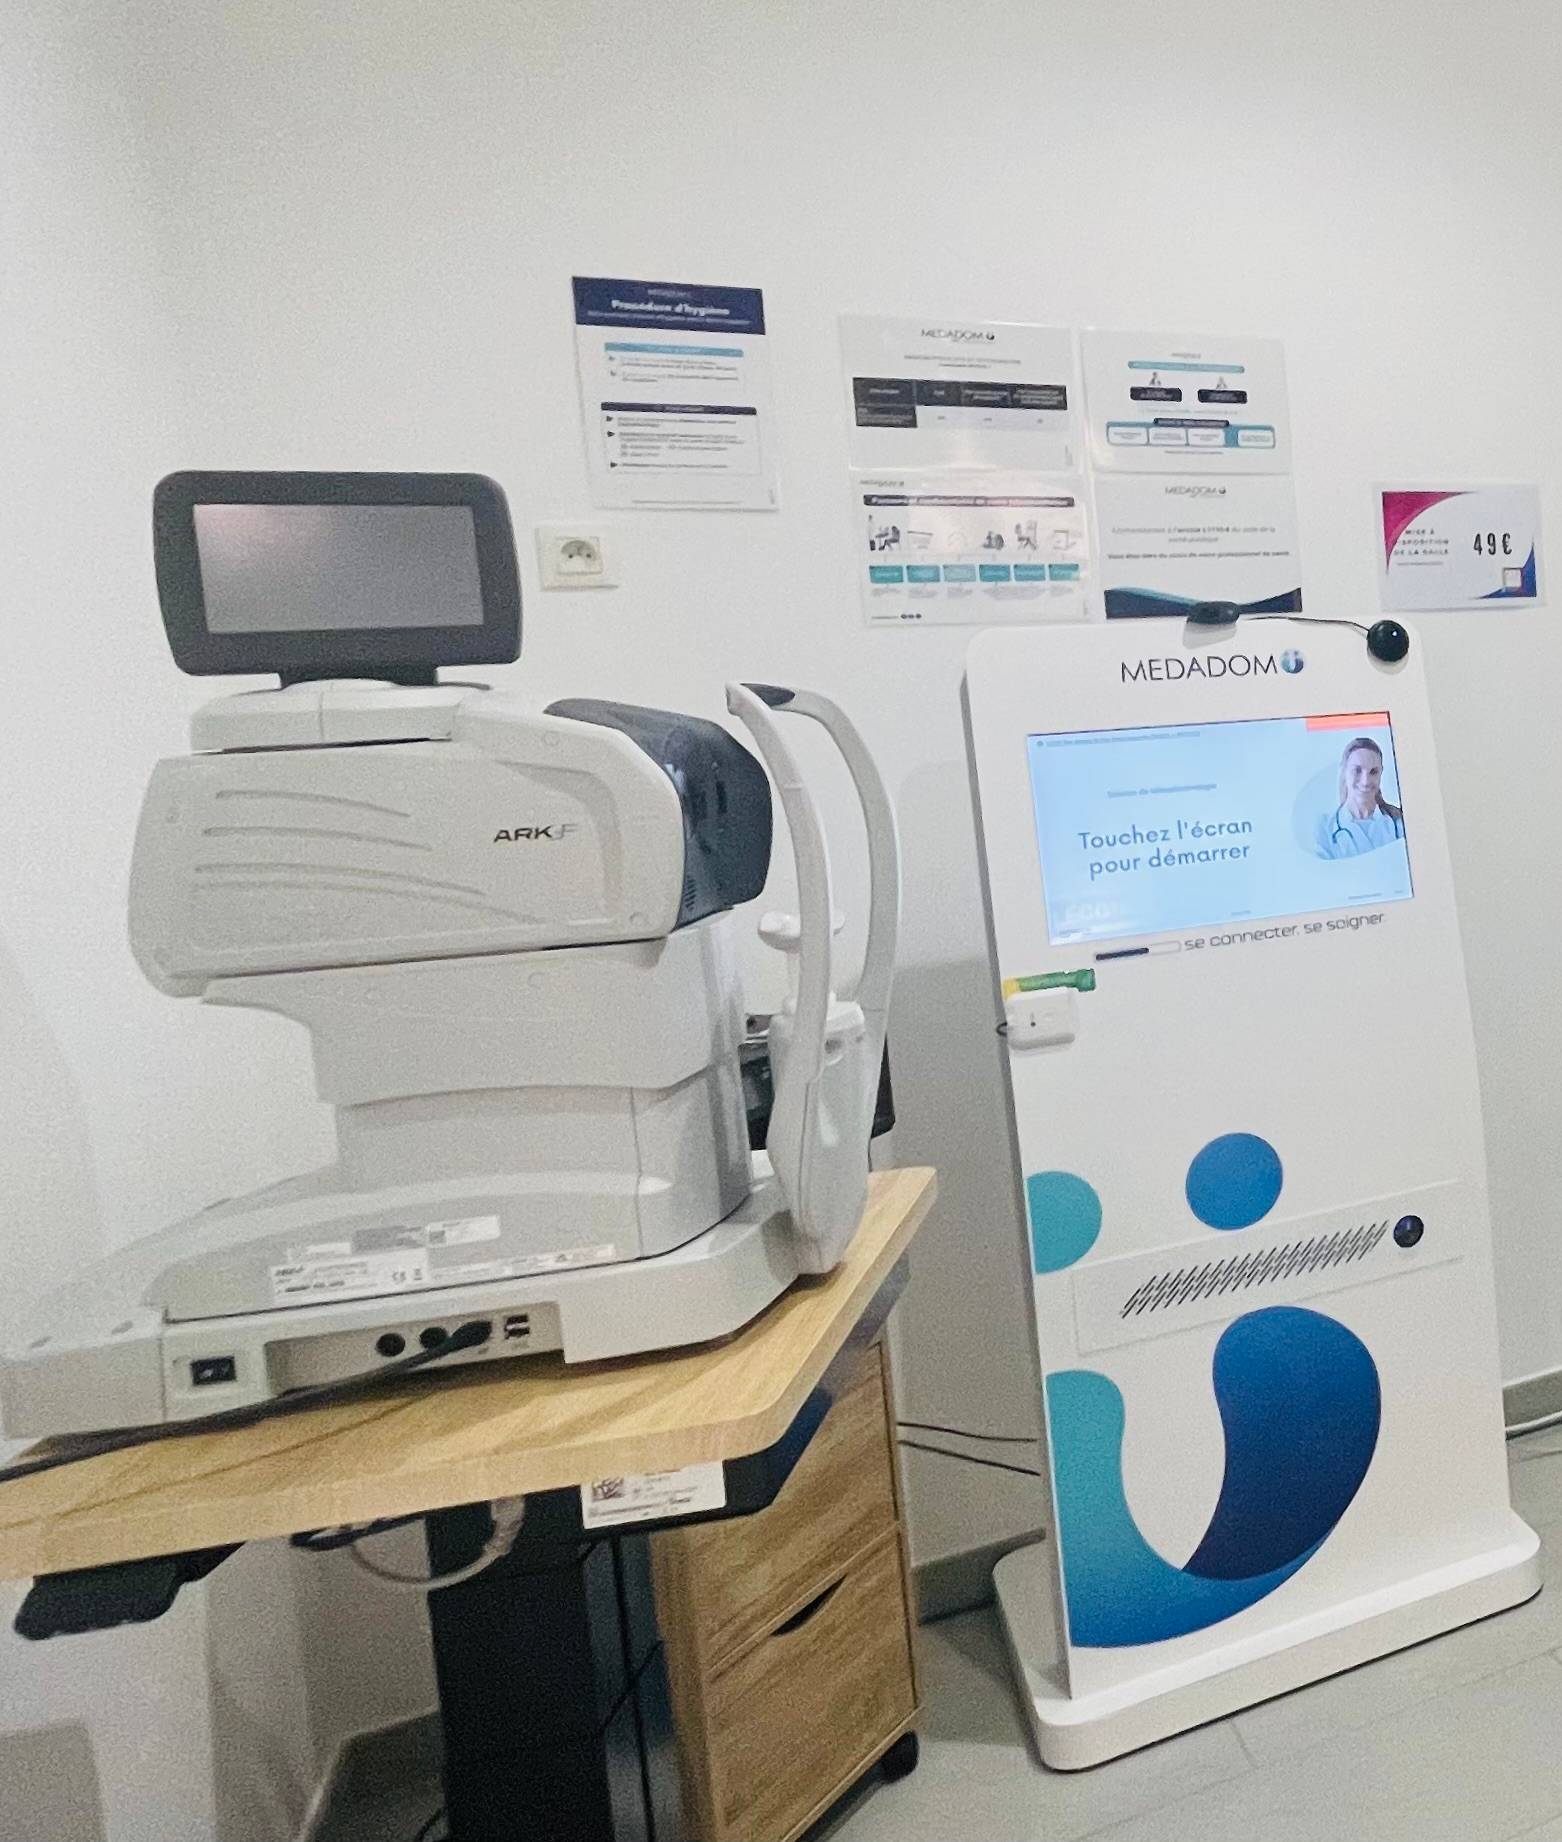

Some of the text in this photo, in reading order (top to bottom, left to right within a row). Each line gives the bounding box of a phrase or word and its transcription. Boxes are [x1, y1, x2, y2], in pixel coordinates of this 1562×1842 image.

[1121, 654, 1278, 683] MEDADOM
[1078, 819, 1253, 850] Touchez l'écran
[1089, 845, 1252, 881] pour démarrer
[1184, 939, 1206, 951] se
[1303, 922, 1323, 935] se
